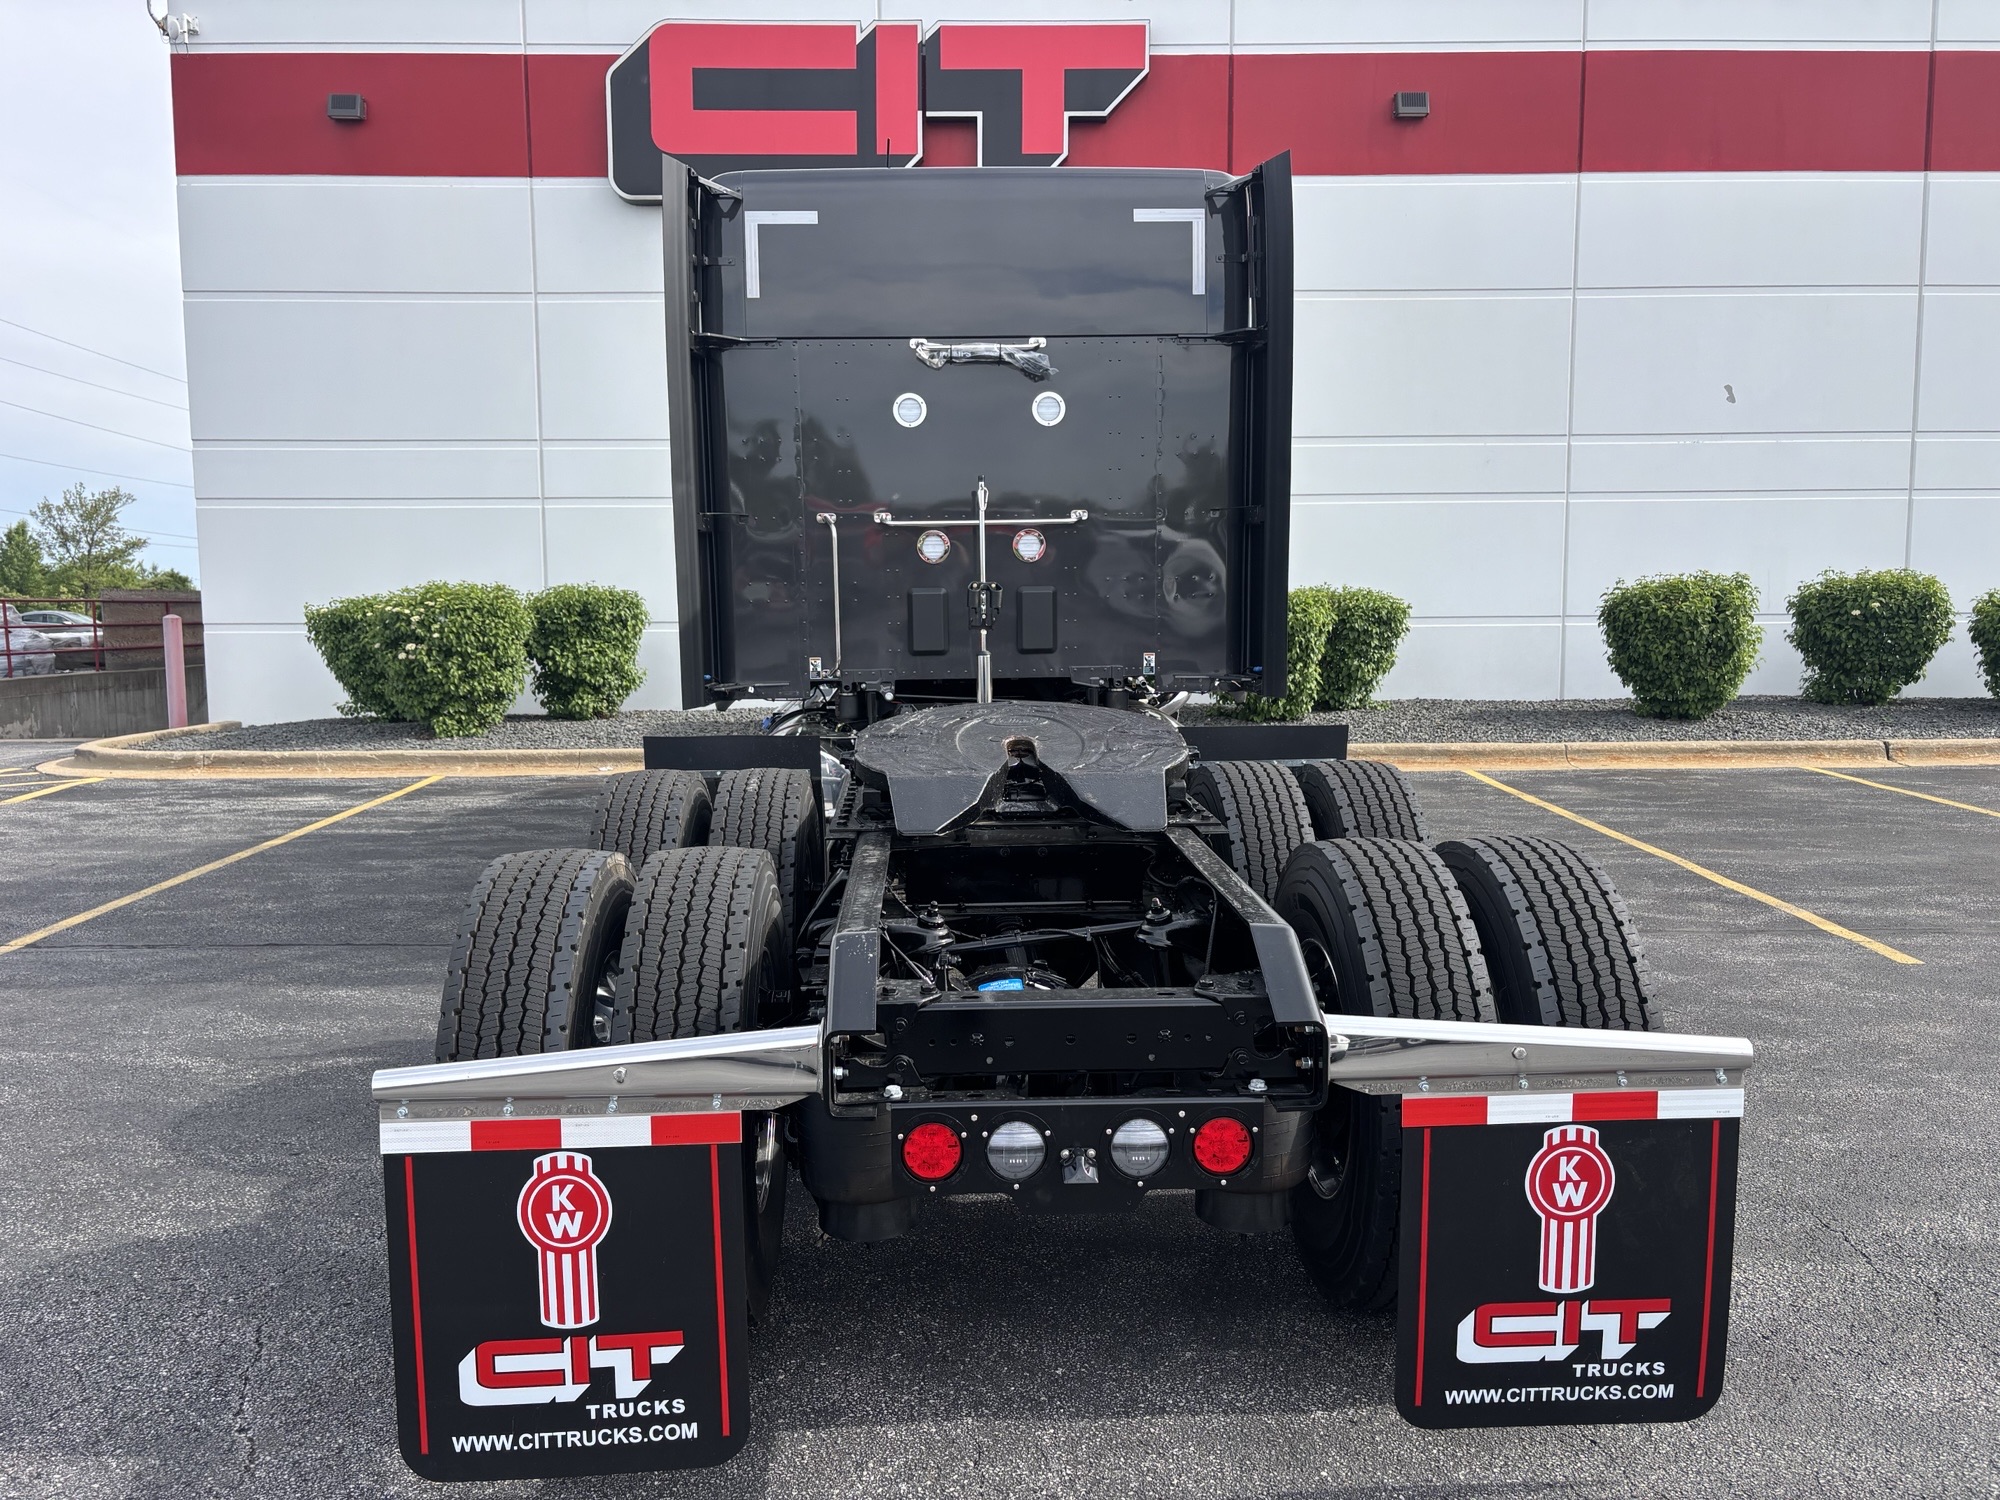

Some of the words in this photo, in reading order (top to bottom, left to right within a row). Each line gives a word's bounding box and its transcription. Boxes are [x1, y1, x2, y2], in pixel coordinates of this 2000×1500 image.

[606, 19, 1151, 203] CIT
[1456, 1298, 1671, 1364] CIT
[458, 1330, 685, 1406] CIT
[1572, 1362, 1666, 1378] TRUCKS
[586, 1399, 686, 1419] TRUCKS
[1445, 1384, 1674, 1405] WWW.CITTRUCKS.COM
[452, 1423, 698, 1453] WWW.CITTRUCKS.COM
